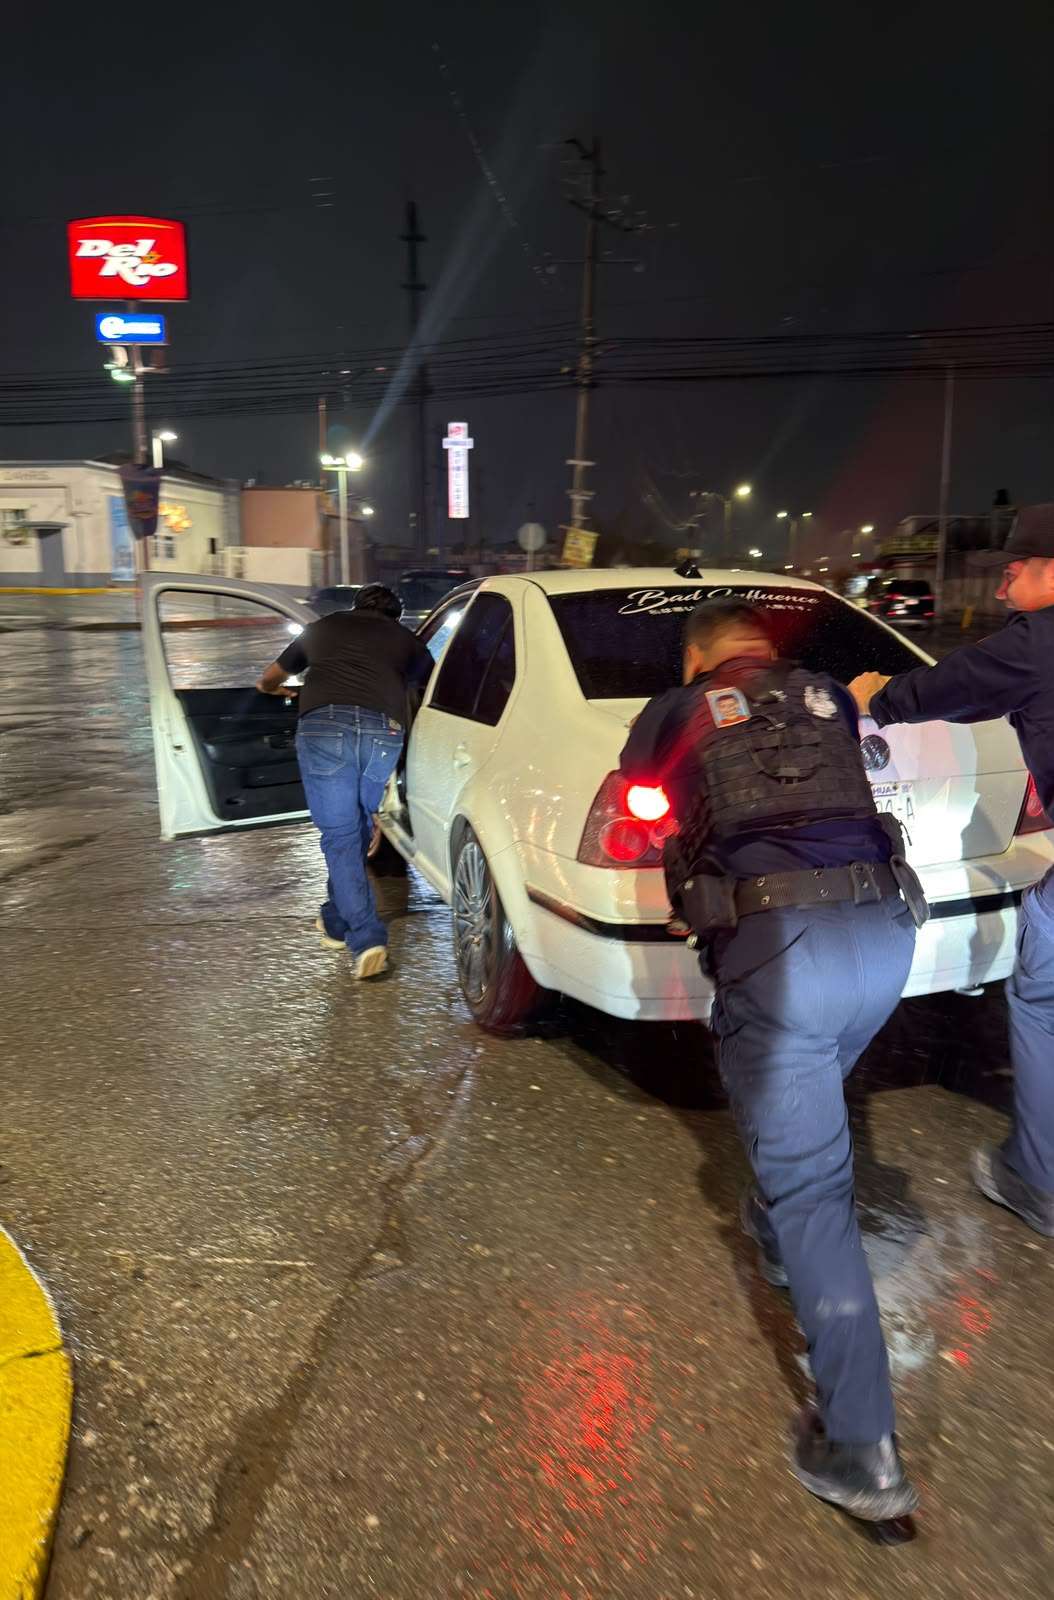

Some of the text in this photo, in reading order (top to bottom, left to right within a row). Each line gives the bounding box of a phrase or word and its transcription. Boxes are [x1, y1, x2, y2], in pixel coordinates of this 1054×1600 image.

[75, 239, 156, 257] Del
[98, 256, 179, 286] Rio
[618, 589, 703, 615] Bad
